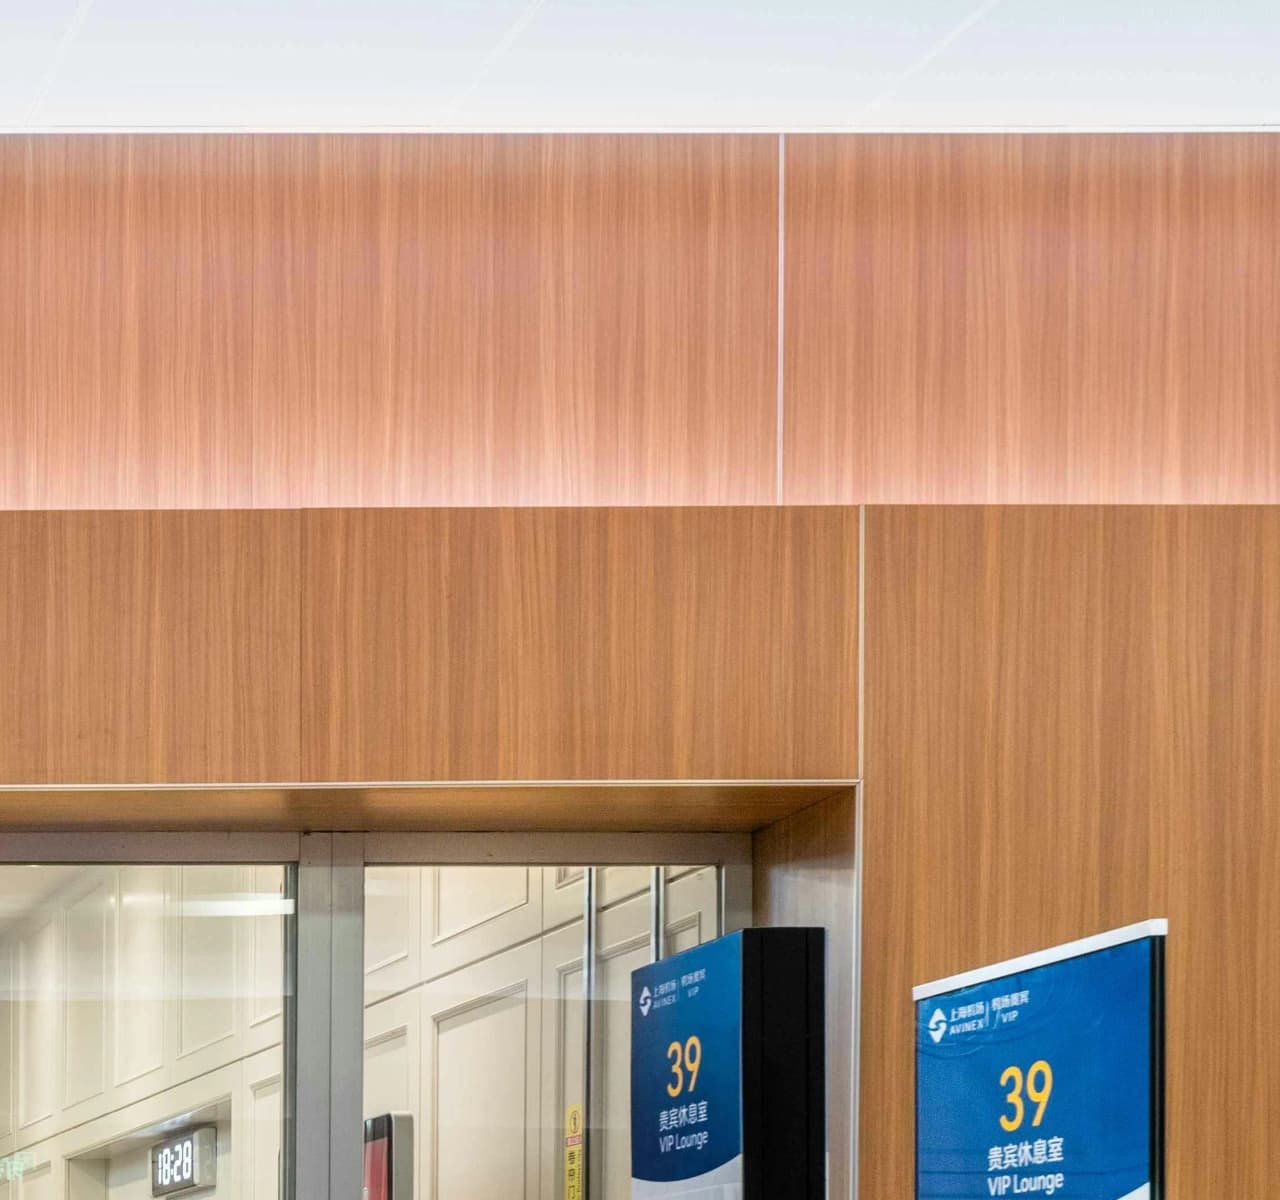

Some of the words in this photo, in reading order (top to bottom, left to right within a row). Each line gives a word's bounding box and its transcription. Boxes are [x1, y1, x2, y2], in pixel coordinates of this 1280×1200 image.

[949, 1018, 985, 1036] AVINEX
[1001, 1010, 1019, 1023] VIP
[667, 1035, 702, 1098] 39
[1000, 1060, 1053, 1132] 39
[659, 1100, 708, 1132] 贵宾休息室
[659, 1134, 673, 1153] VIP
[675, 1131, 709, 1150] Lounge
[987, 1136, 1064, 1171] 贵宾休息室
[158, 1140, 192, 1186] 18:28
[987, 1175, 1011, 1196] VIP
[1013, 1172, 1064, 1195] Lounge
